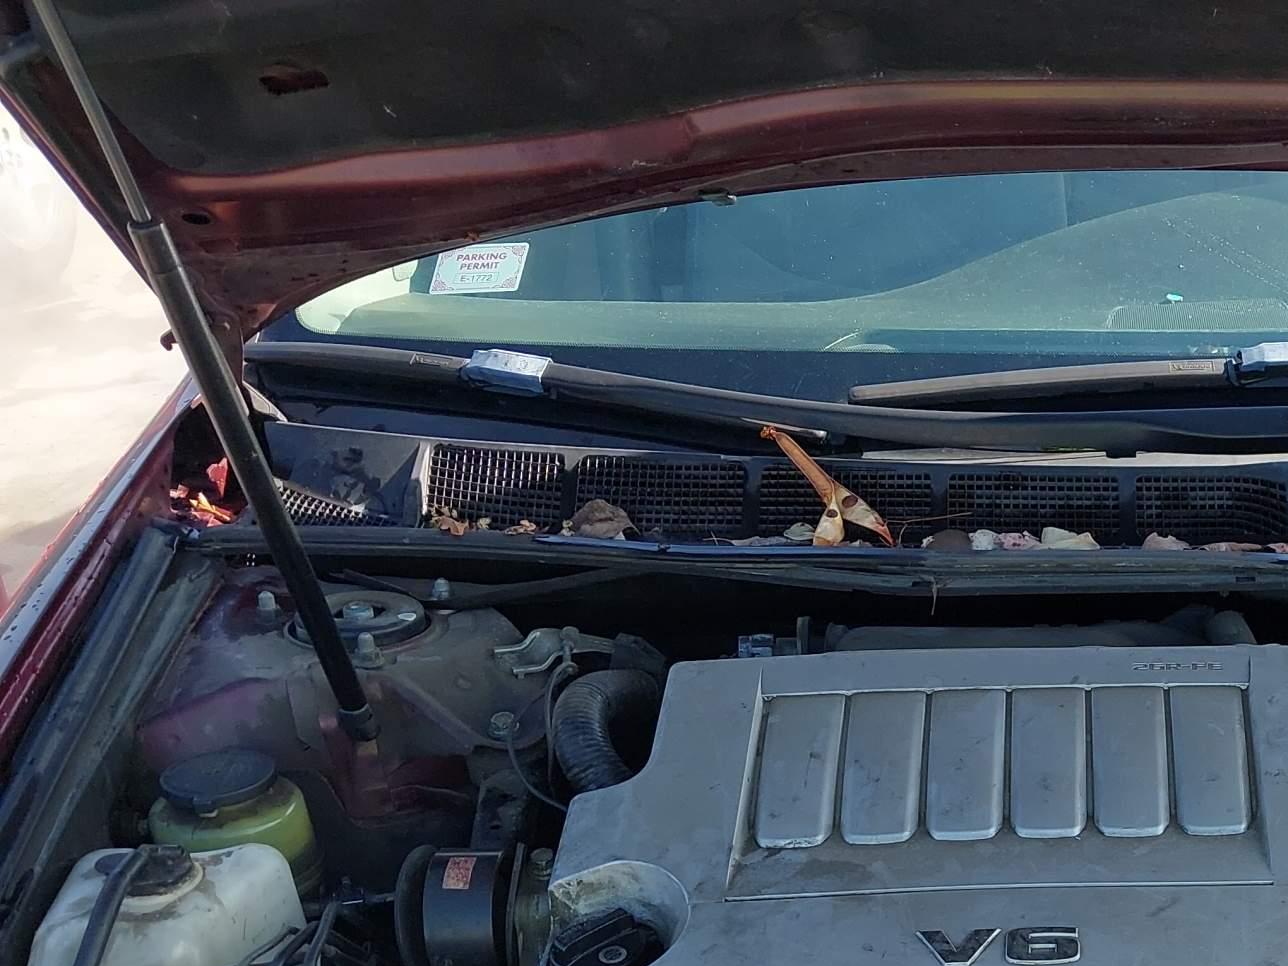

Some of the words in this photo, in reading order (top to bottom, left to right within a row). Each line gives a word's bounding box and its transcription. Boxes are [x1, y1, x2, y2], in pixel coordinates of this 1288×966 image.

[456, 252, 507, 262] PARKING
[460, 262, 500, 270] PERMIT
[460, 274, 493, 283] E-1772
[1132, 662, 1224, 671] 2GR-FE
[915, 926, 1082, 966] V6
